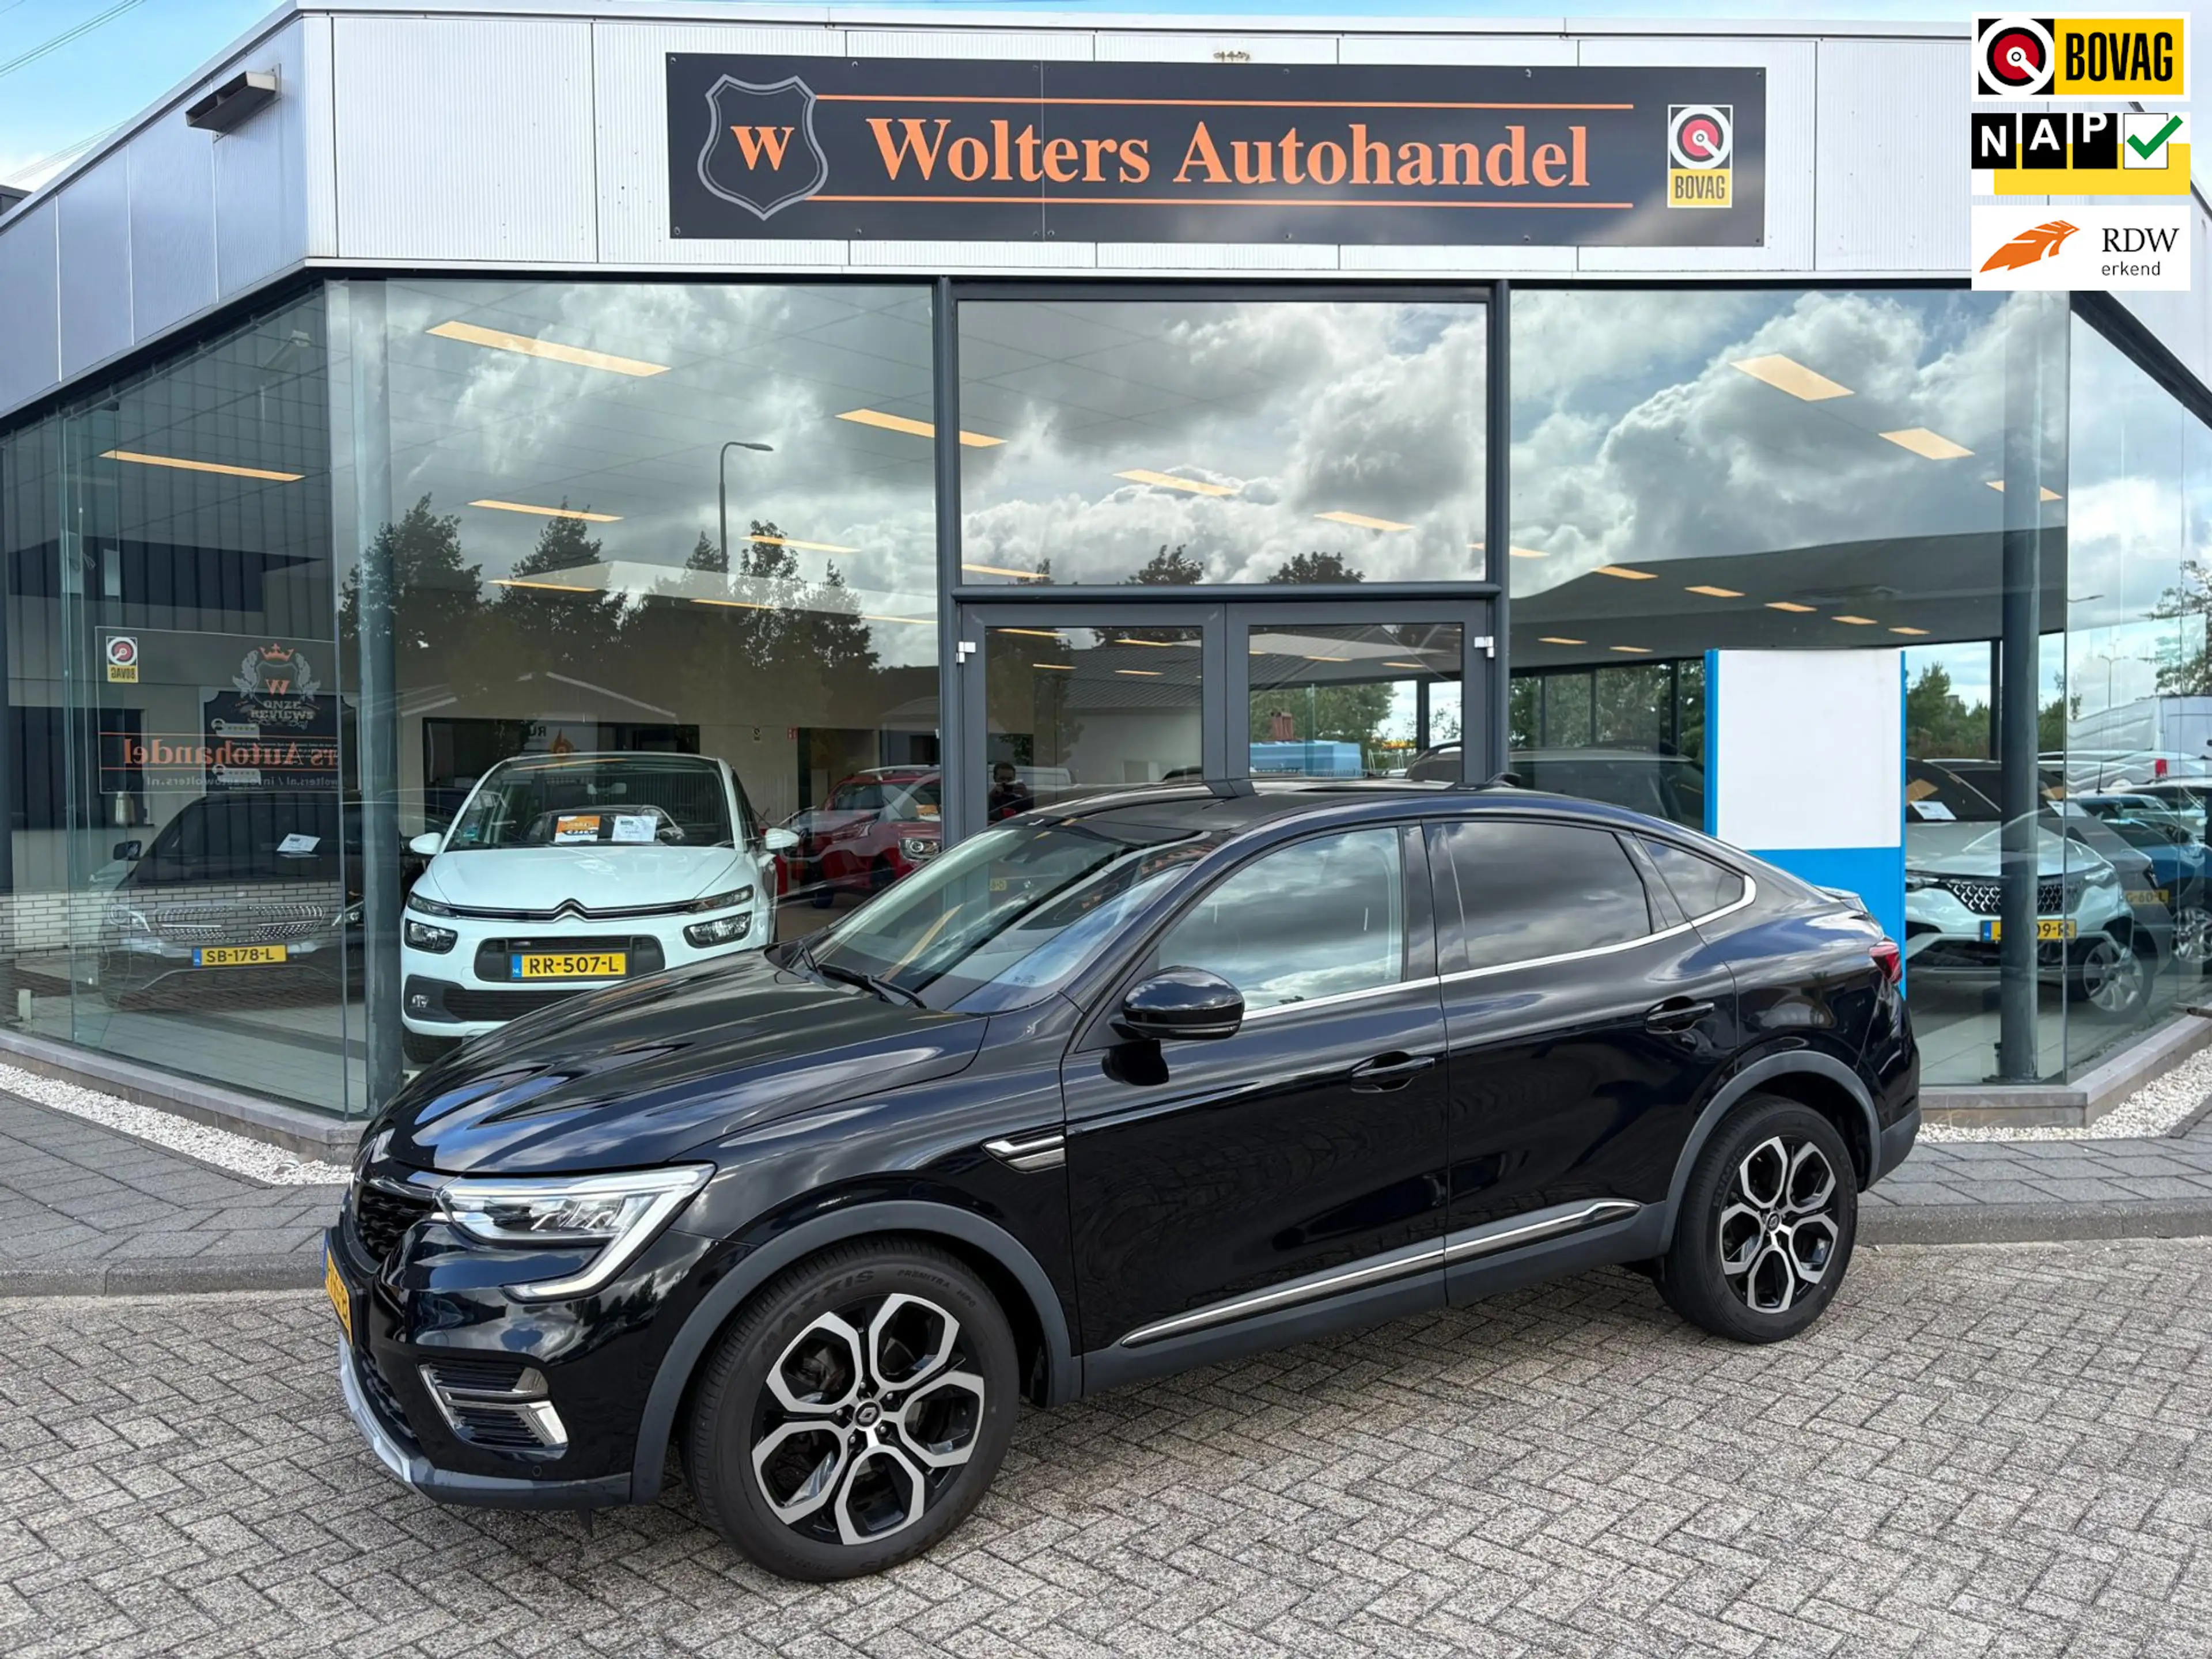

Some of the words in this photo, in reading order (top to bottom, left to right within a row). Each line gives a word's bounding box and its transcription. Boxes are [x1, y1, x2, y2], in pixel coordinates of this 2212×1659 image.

[730, 125, 796, 171] W
[865, 118, 1150, 183] Wolters
[1172, 121, 1590, 187] Autohandel
[1674, 175, 1726, 199] BOVAG
[206, 948, 275, 963] SB-178-L
[529, 956, 619, 974] RR-507-L
